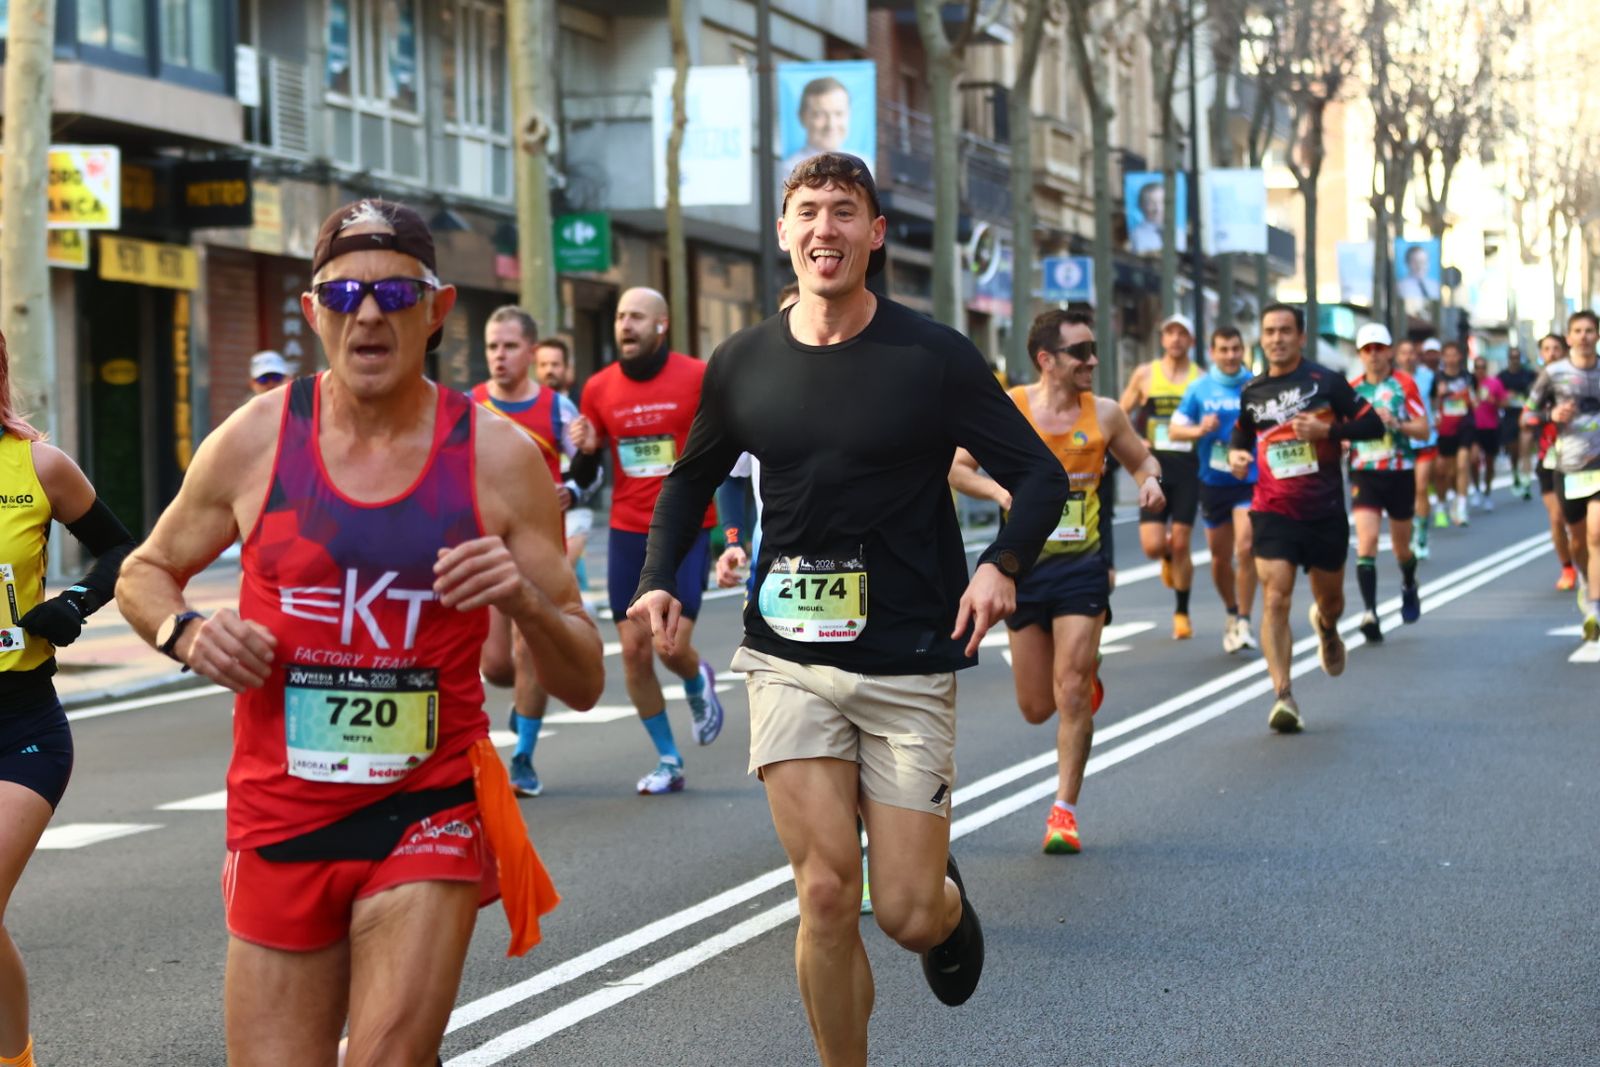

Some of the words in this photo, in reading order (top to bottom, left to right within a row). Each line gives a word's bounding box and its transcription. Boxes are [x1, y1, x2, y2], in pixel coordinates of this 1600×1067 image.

[815, 559, 835, 568] 2026
[778, 577, 848, 600] 2174
[818, 629, 858, 638] bedunia
[294, 647, 364, 665] FACTORY
[371, 655, 417, 669] TEAM
[370, 673, 398, 684] 2026
[325, 696, 398, 728] 720
[342, 734, 374, 743] NEFTA
